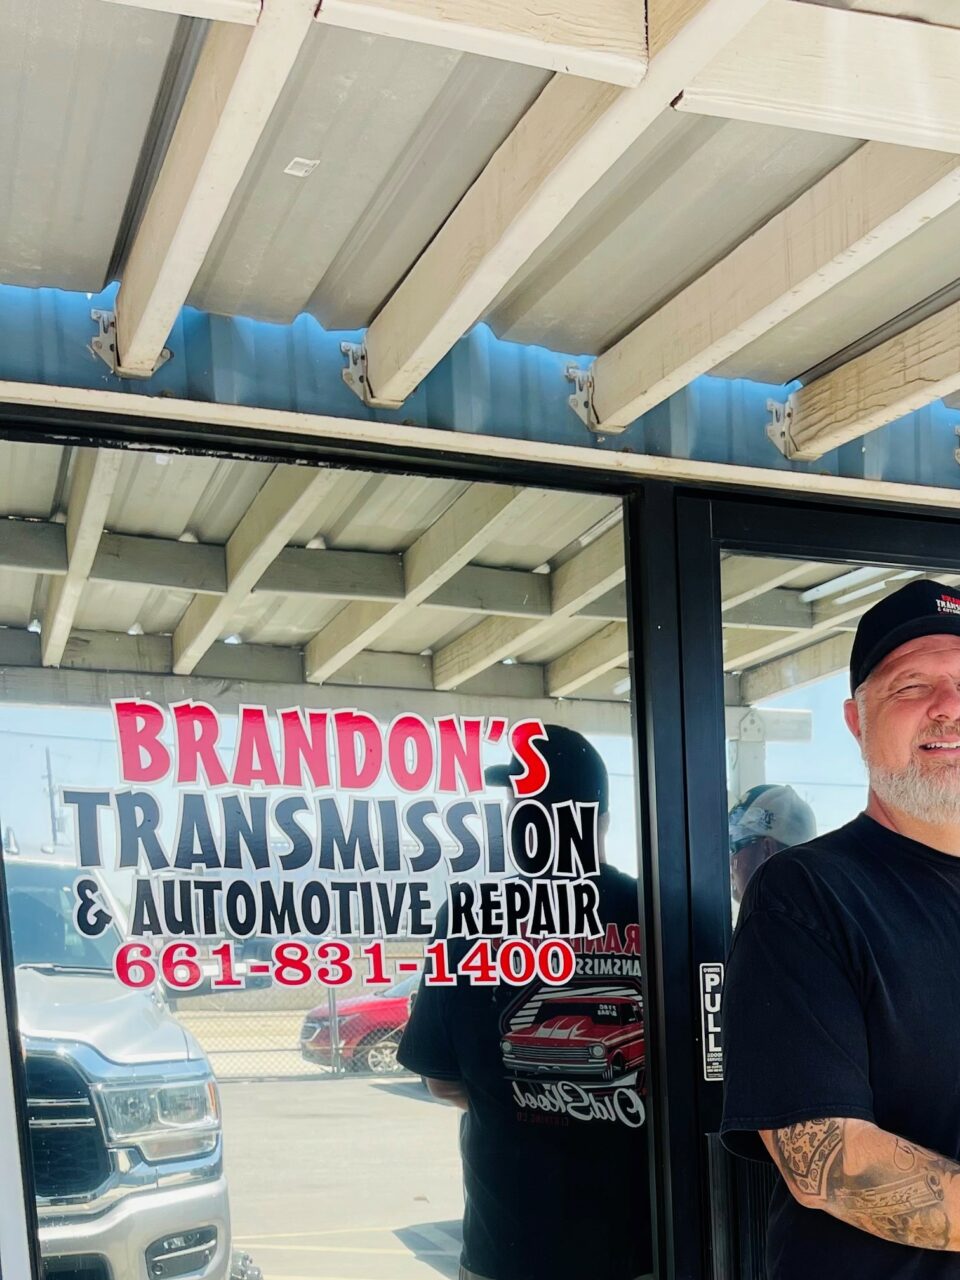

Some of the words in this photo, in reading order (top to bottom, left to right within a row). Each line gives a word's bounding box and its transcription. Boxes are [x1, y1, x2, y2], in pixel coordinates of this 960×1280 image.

[111, 698, 551, 798] BRANDON'S
[62, 787, 600, 877] TRANSMISSION
[73, 878, 114, 938] &
[130, 878, 437, 939] AUTOMOTIVE
[447, 876, 605, 941] REPAIR
[112, 938, 576, 991] 661-831-1400
[705, 973, 722, 1052] PULL
